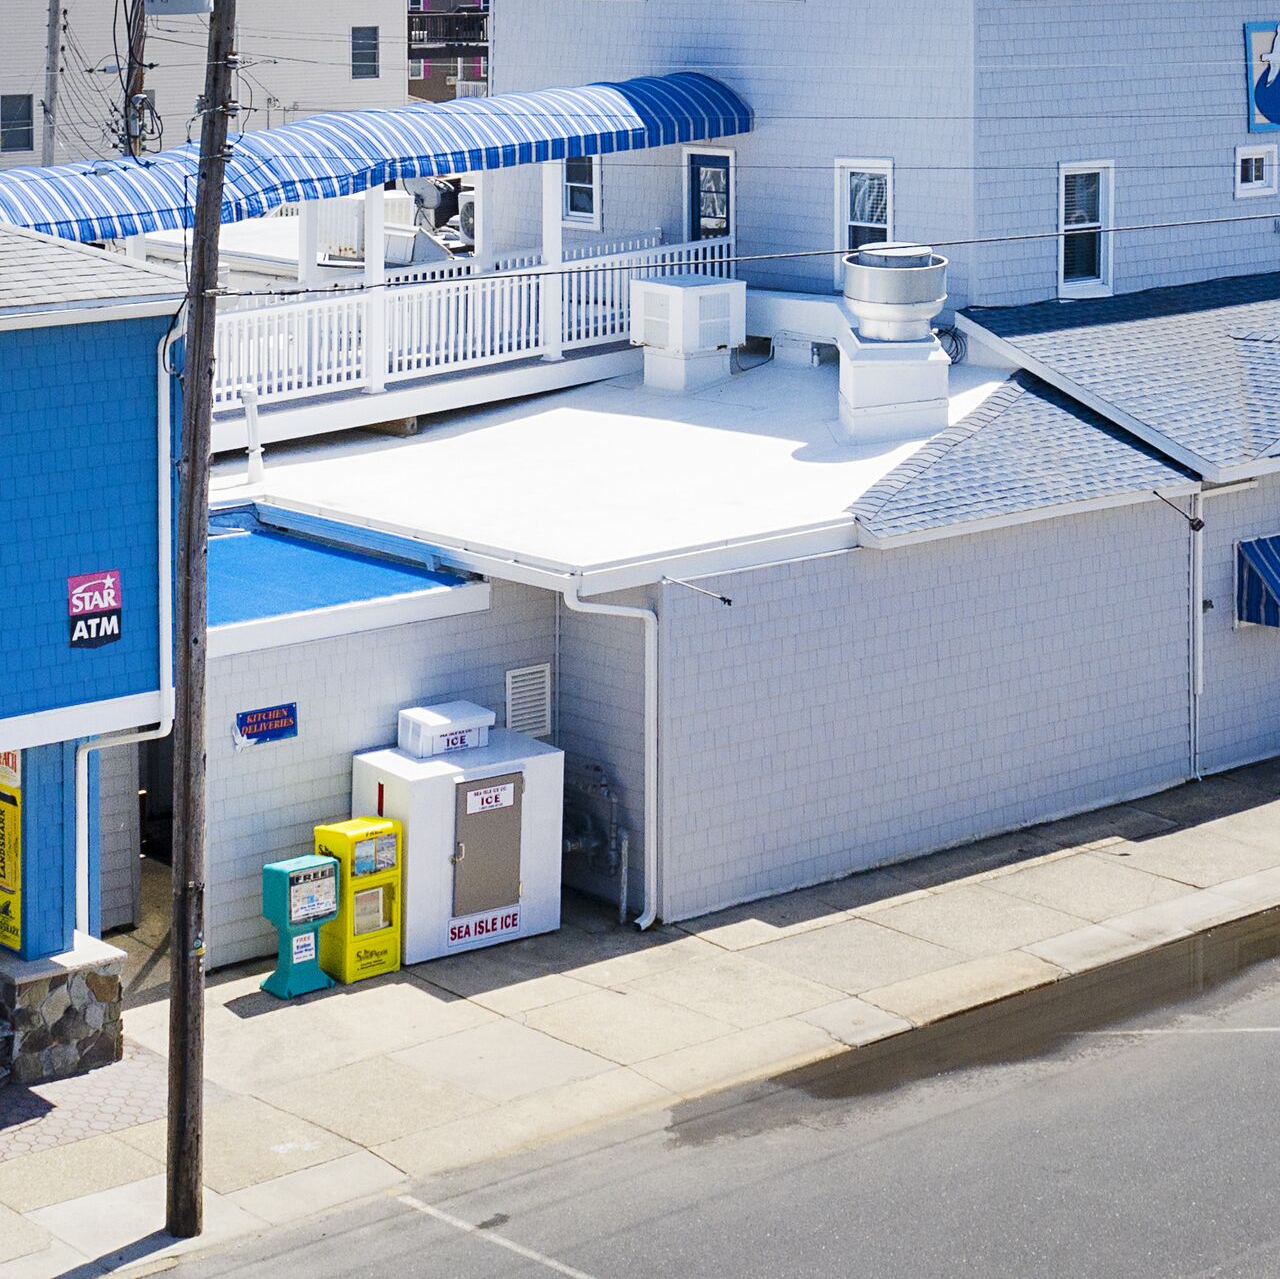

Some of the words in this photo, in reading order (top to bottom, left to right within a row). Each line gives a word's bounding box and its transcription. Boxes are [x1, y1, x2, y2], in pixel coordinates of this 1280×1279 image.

[71, 588, 118, 613] STAR
[72, 615, 119, 642] ATM
[246, 708, 288, 723] KITCHEN
[241, 717, 294, 735] DELIVERIES
[446, 735, 466, 747] ICE
[480, 794, 500, 806] ICE
[450, 925, 471, 941] SEA
[474, 917, 498, 936] ISLE
[500, 913, 519, 930] ICE
